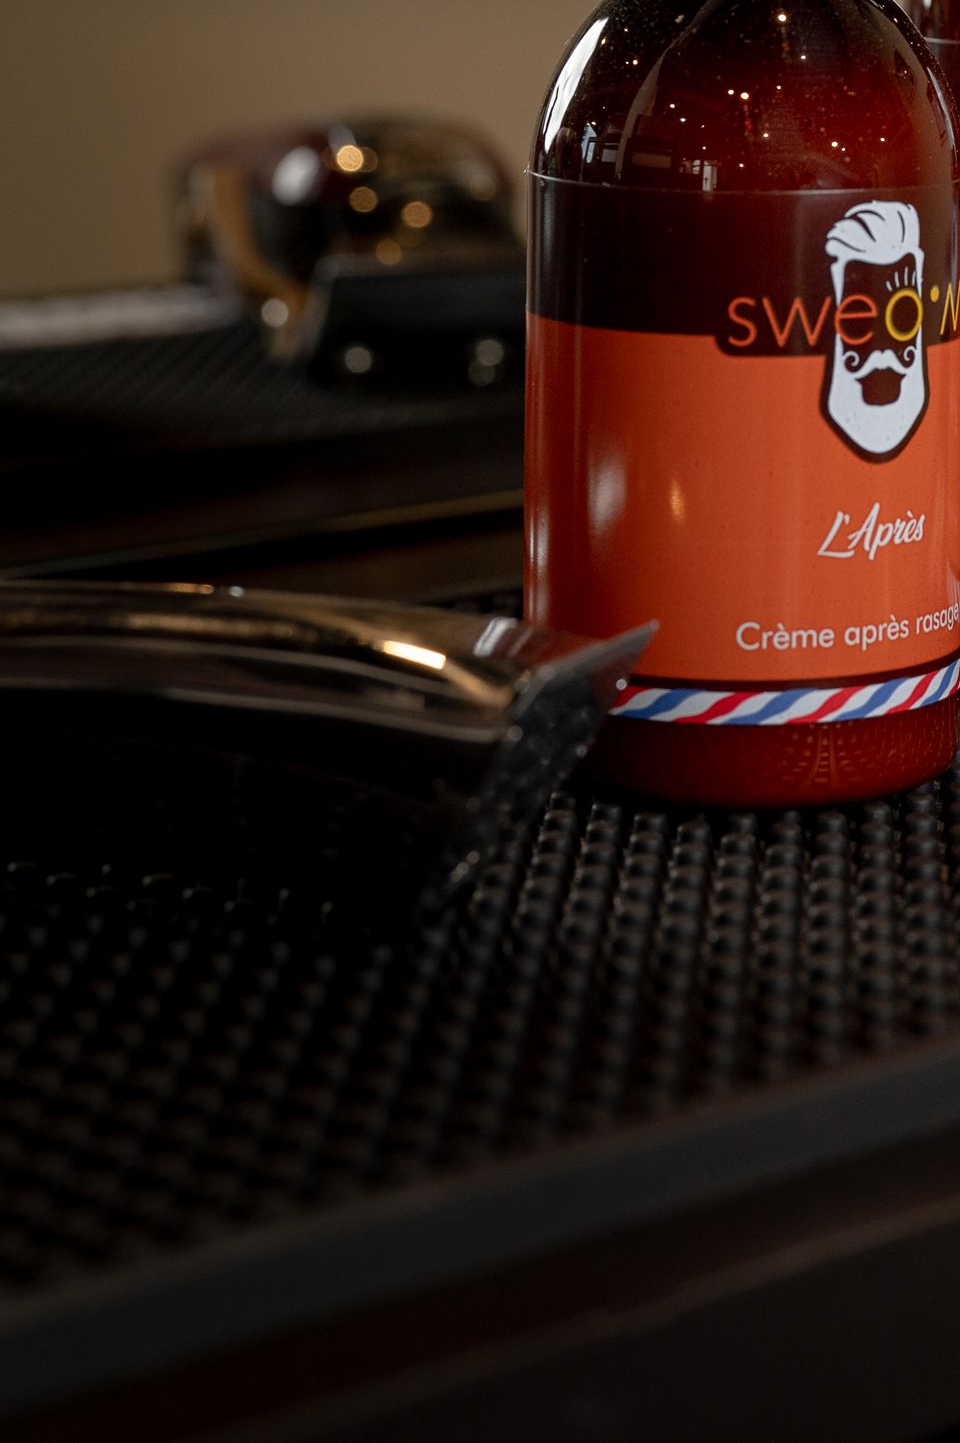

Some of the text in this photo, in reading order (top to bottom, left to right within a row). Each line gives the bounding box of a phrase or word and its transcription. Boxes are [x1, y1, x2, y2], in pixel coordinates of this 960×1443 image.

[816, 501, 926, 561] L'Après
[735, 602, 960, 651] Crème après rasage
